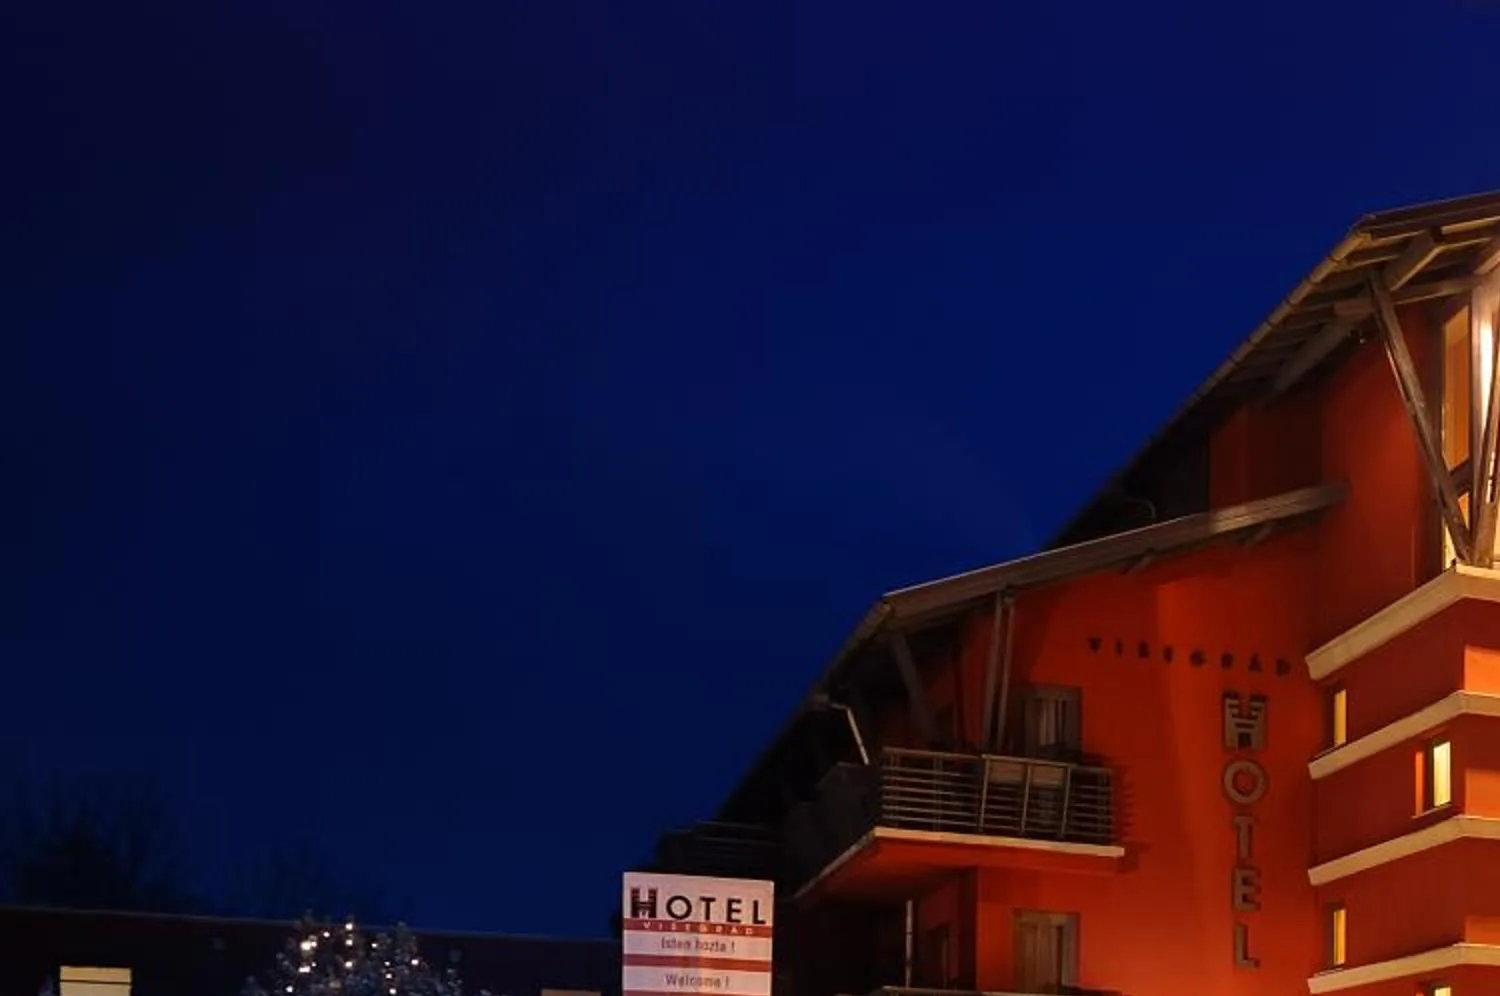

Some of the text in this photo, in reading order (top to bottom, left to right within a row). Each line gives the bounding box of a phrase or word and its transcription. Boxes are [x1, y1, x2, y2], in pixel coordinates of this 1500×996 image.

[1222, 690, 1269, 969] HOTEL
[630, 887, 767, 925] HOTEL
[665, 974, 721, 988] Welcome
